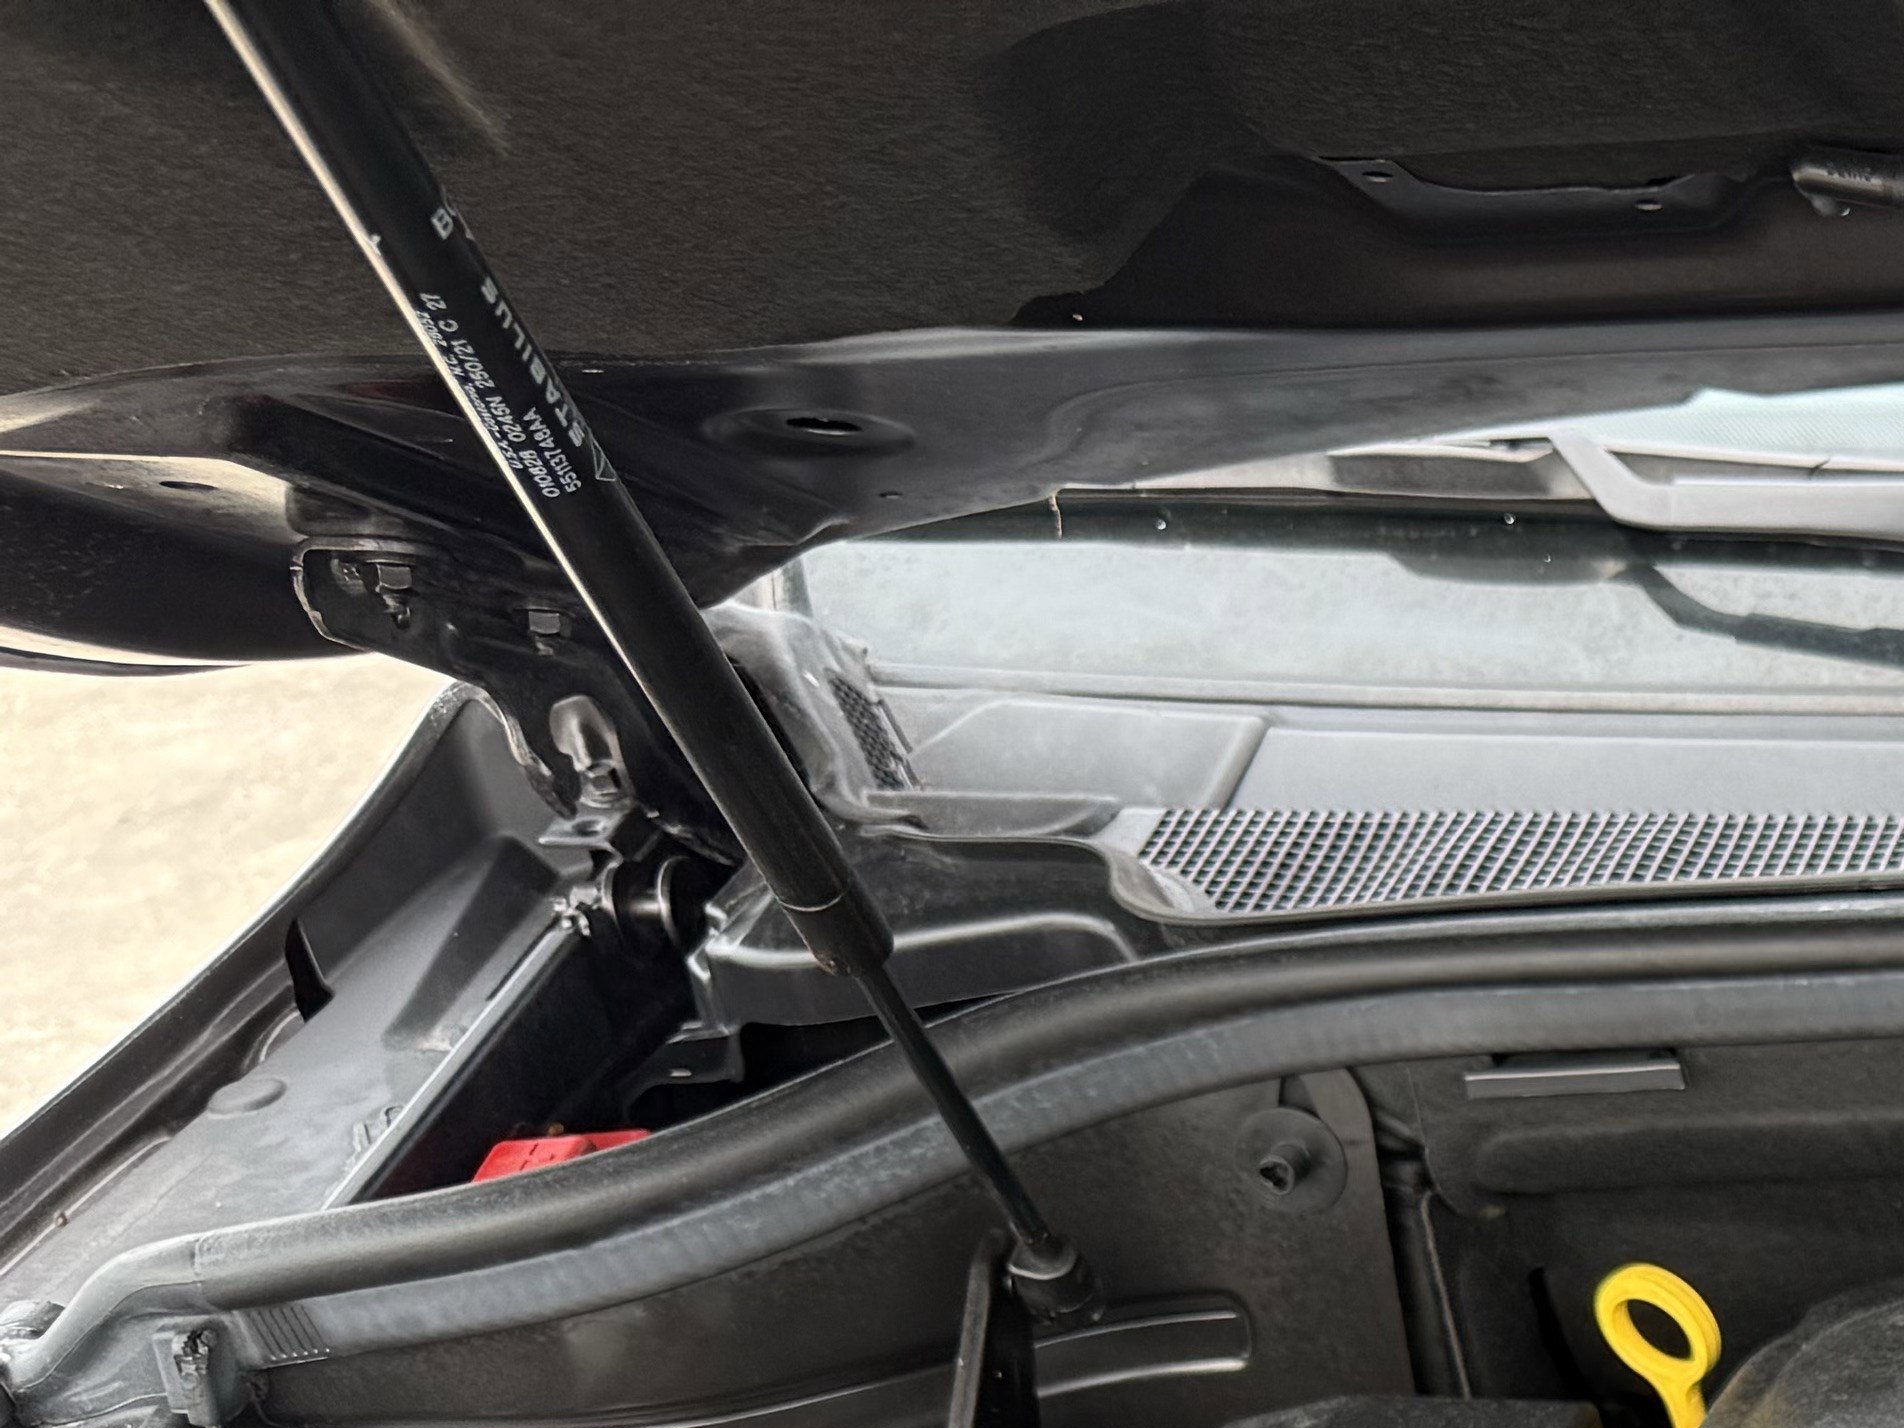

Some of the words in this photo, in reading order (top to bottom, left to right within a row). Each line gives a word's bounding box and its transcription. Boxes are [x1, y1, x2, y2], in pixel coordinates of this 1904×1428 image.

[450, 338, 496, 390] 250/21
[480, 276, 586, 448] STABILUS
[486, 395, 527, 443] 0245N
[518, 449, 561, 499] 010828
[522, 406, 582, 494] 55113748AA
